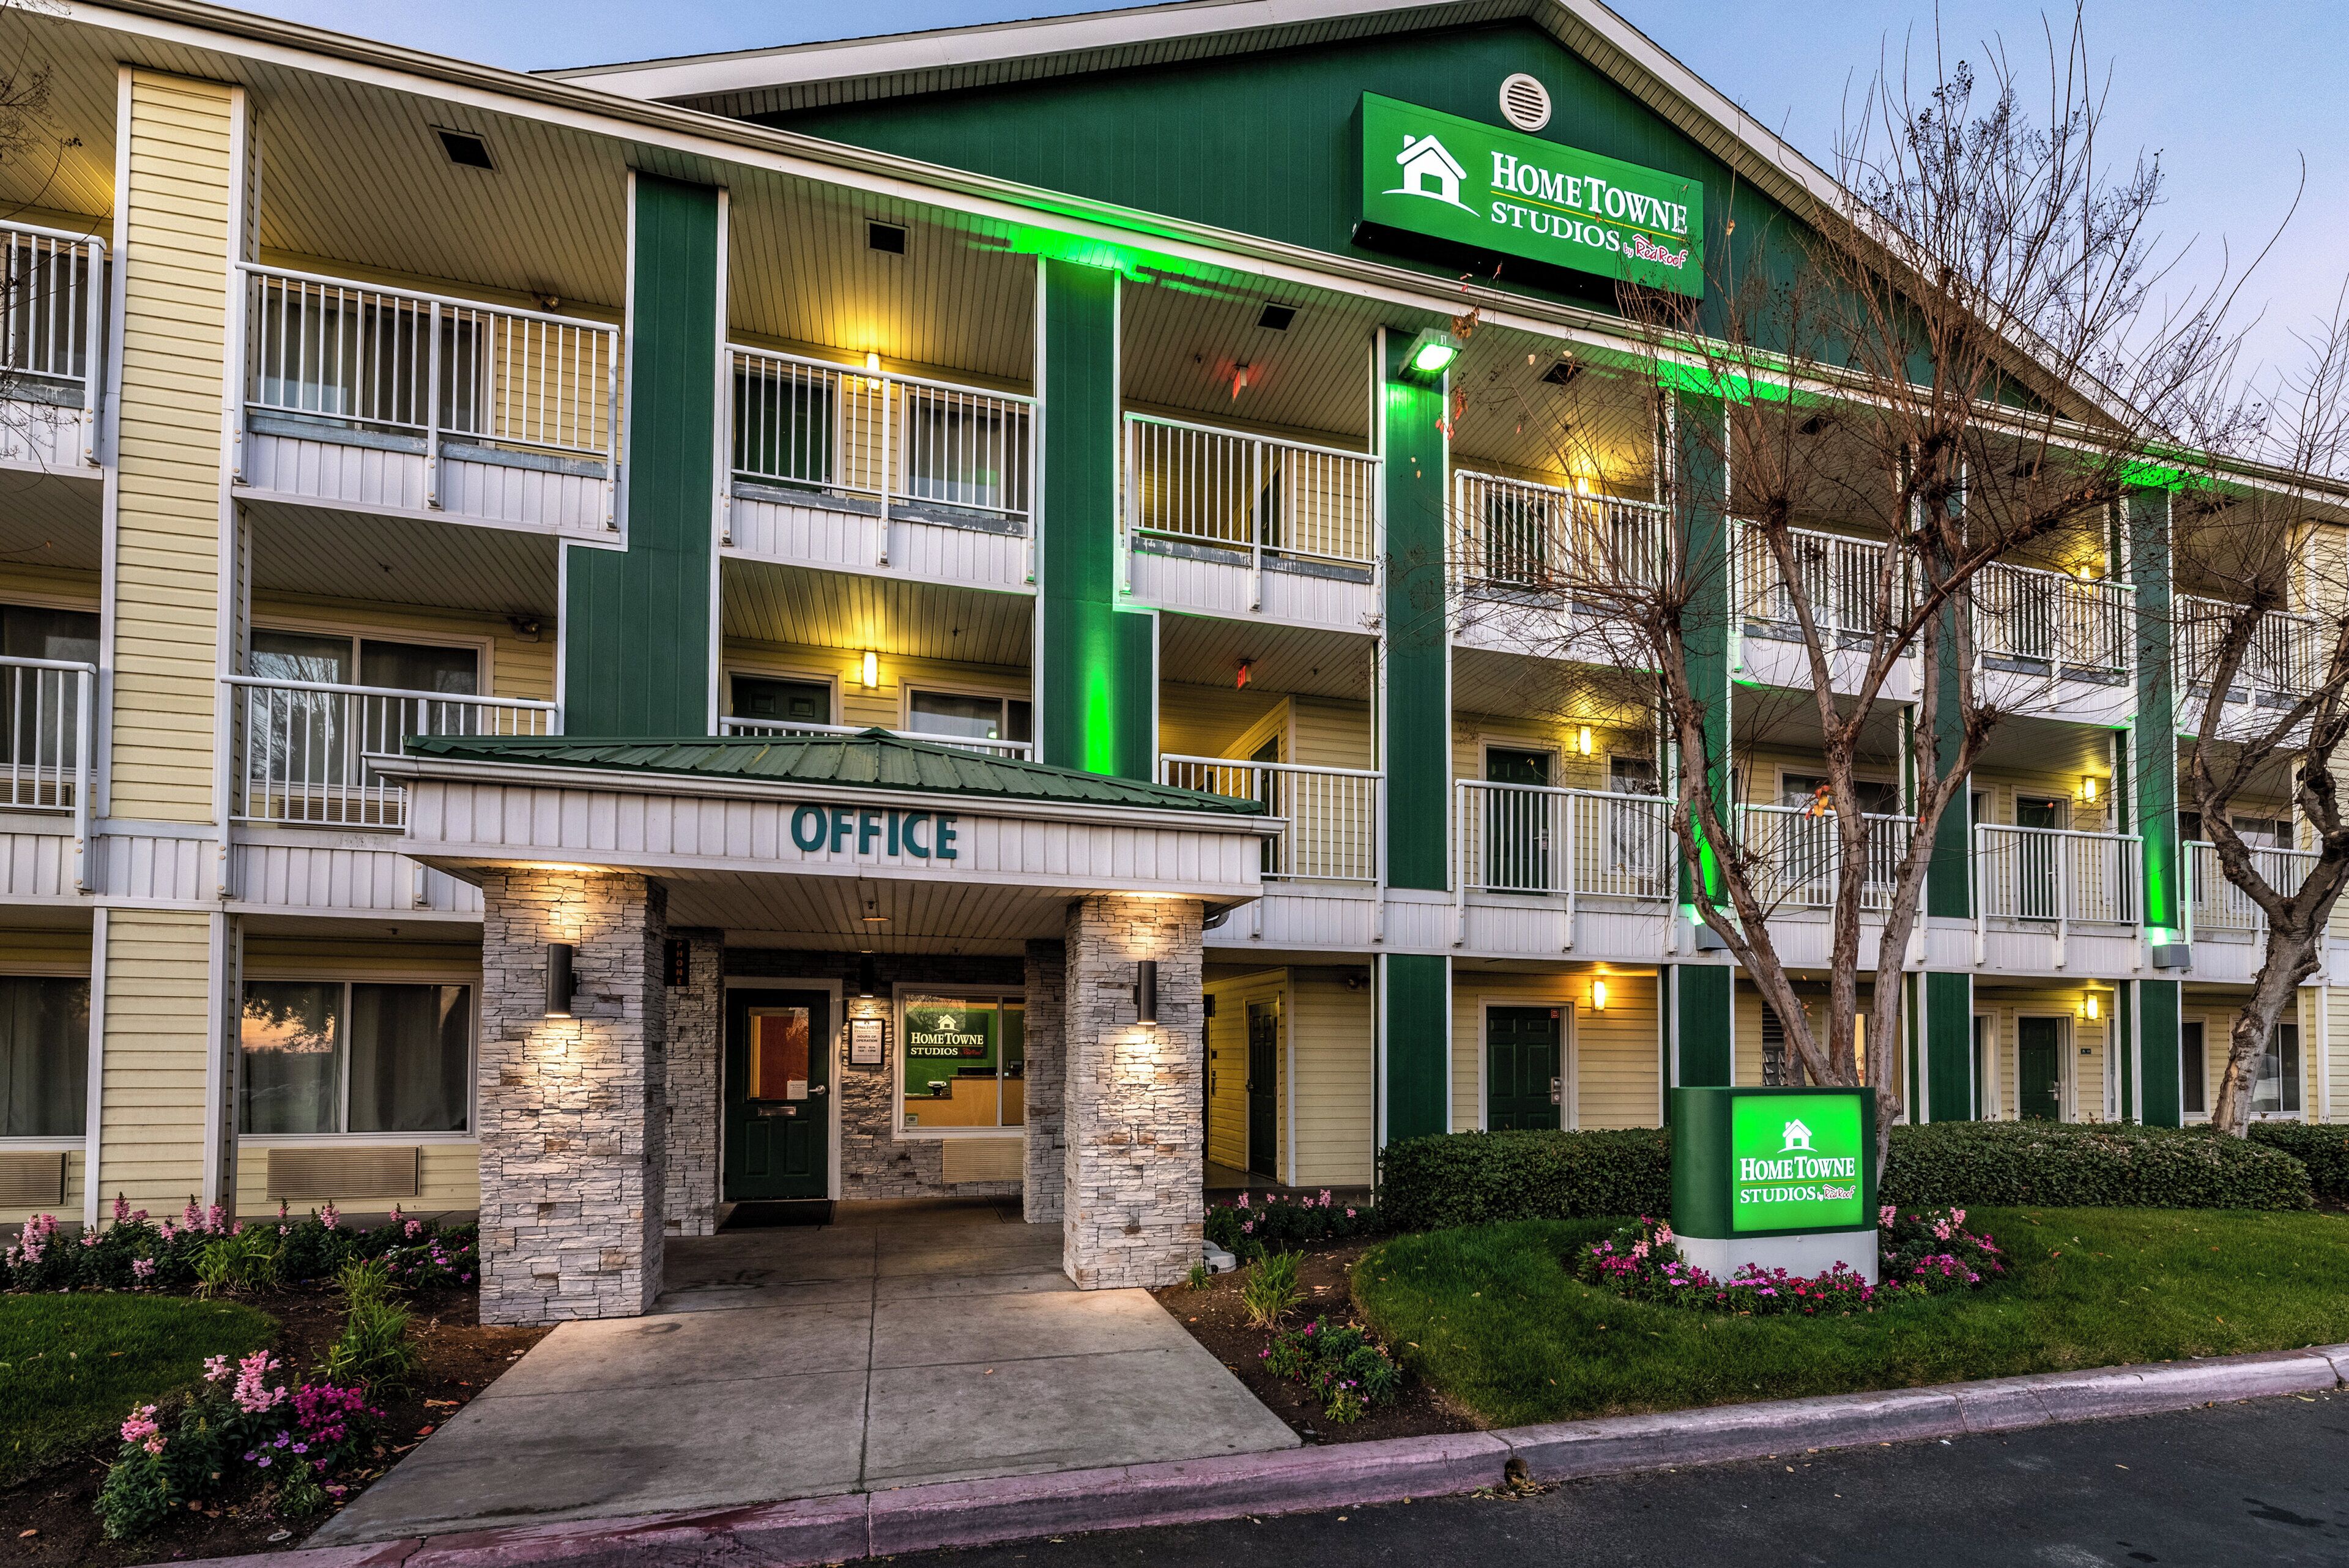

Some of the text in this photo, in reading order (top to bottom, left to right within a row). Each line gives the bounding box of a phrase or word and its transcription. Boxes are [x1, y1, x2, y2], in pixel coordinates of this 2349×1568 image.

[1490, 150, 1688, 234] HOMETOWNE
[1491, 201, 1620, 251] STUDIOS
[1624, 242, 1633, 258] by
[791, 803, 957, 859] OFFICE
[910, 1032, 984, 1045] HOMETOWNE
[1740, 1156, 1855, 1181] HOMETOWNE
[1740, 1186, 1816, 1203] STUDIOS
